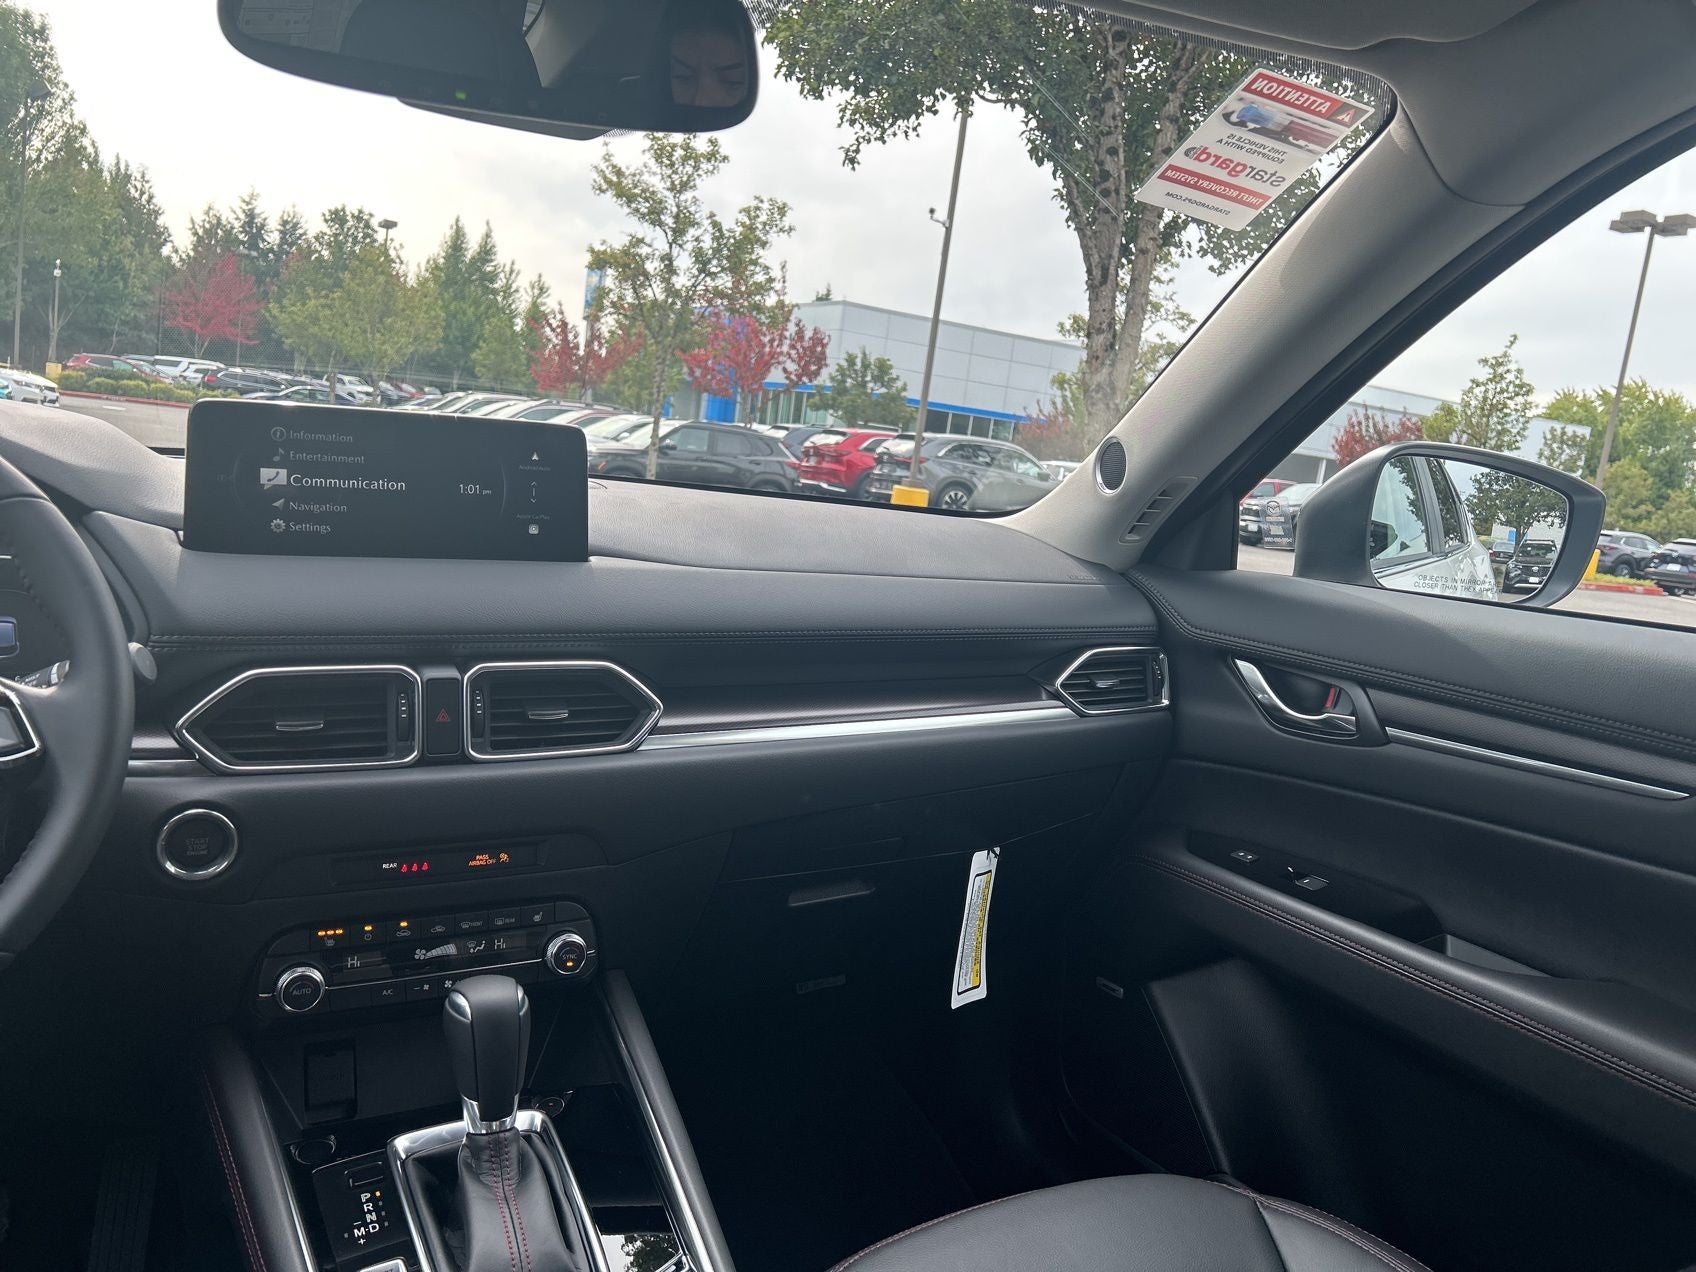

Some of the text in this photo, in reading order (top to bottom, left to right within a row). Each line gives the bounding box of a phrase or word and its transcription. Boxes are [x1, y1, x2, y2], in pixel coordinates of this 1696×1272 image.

[290, 429, 353, 443] Information
[290, 450, 365, 465] Entertainment
[290, 473, 406, 491] Communication
[459, 483, 481, 495] 1:01
[289, 501, 347, 514] Navigation
[289, 521, 331, 534] Settings
[1418, 574, 1449, 583] OBJECTS
[1460, 579, 1486, 587] MIRROR
[1413, 581, 1439, 589] CLOSER
[1441, 583, 1458, 591] THAN
[1460, 585, 1477, 593] THEY
[292, 987, 312, 996] AUTO
[360, 1192, 371, 1202] P
[363, 1202, 374, 1212] R
[365, 1212, 377, 1223] N
